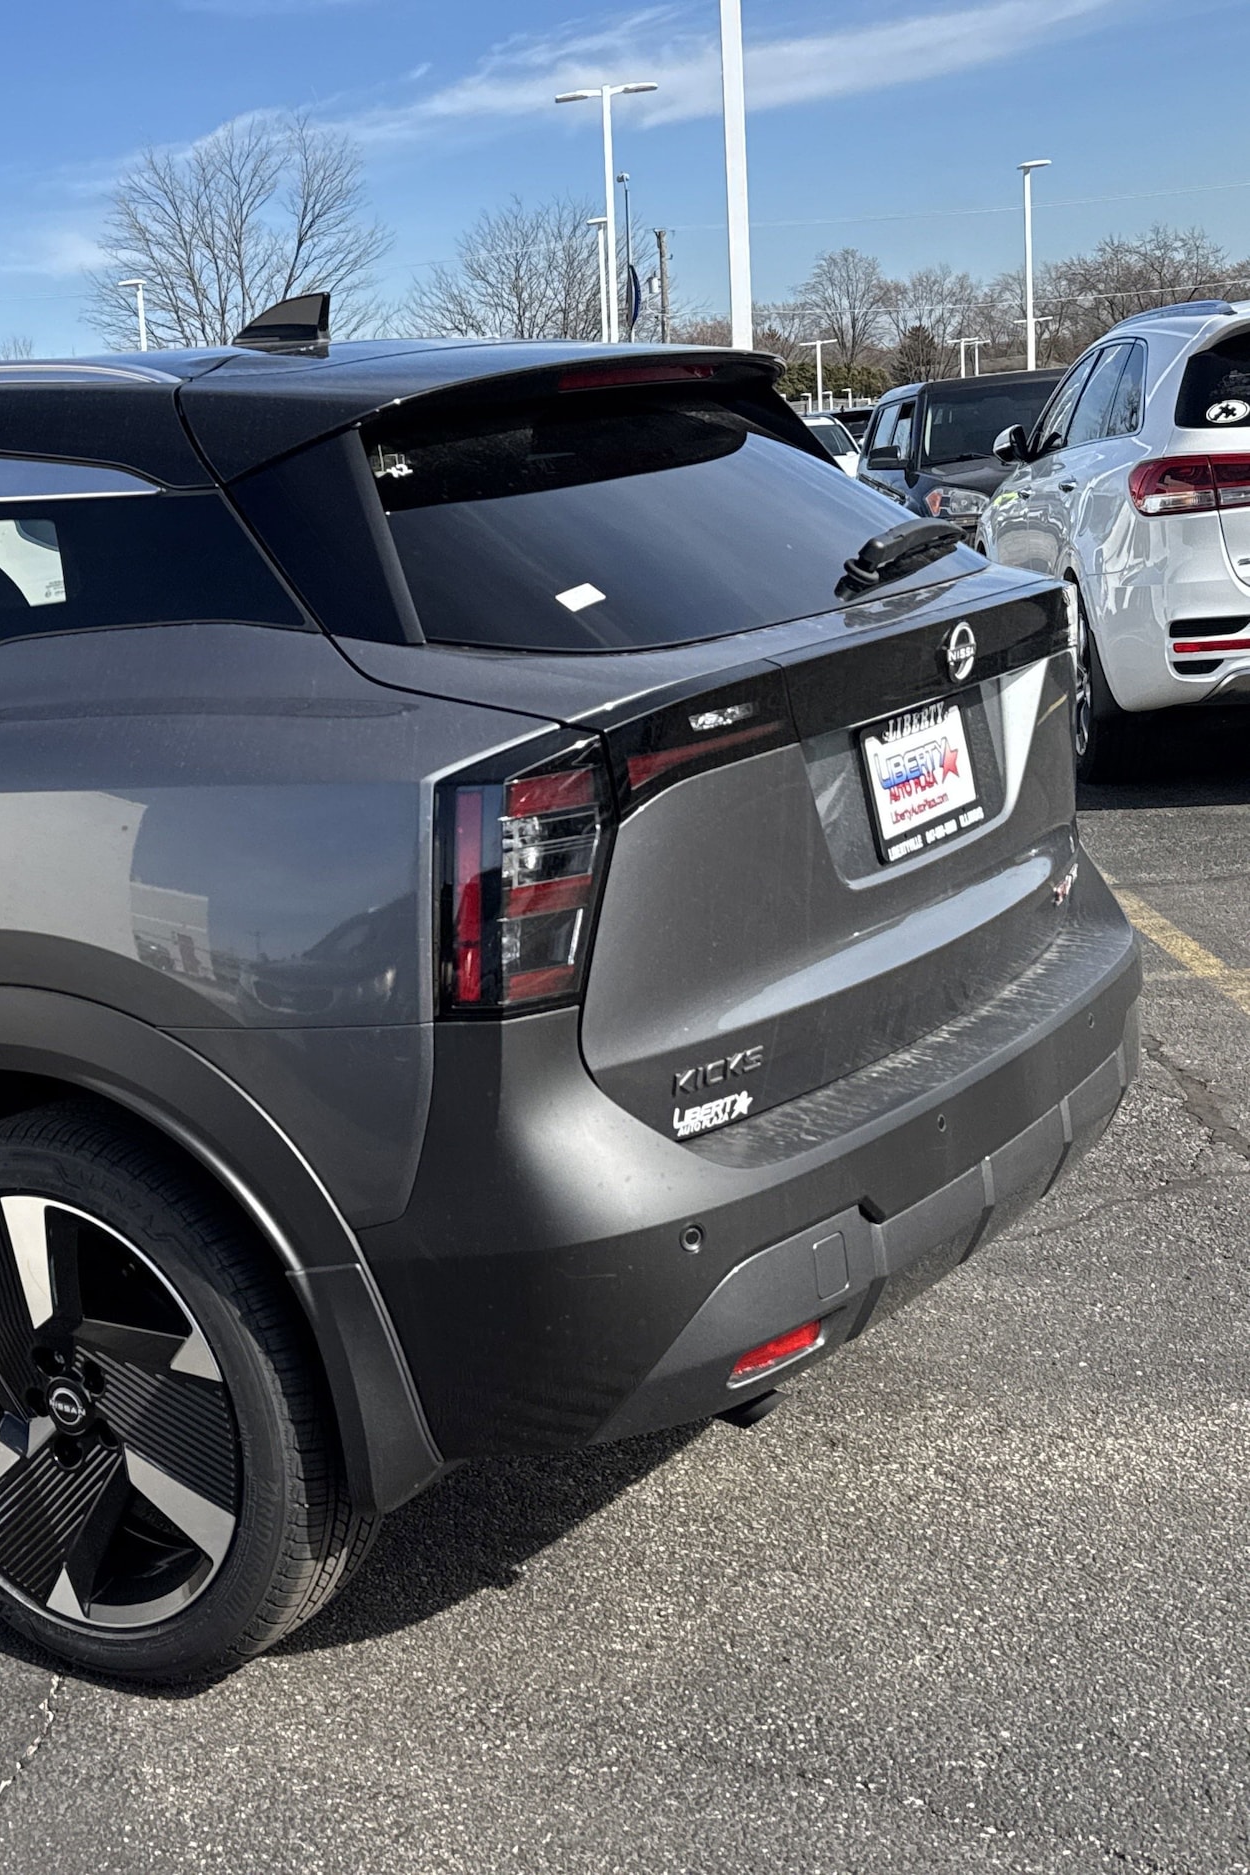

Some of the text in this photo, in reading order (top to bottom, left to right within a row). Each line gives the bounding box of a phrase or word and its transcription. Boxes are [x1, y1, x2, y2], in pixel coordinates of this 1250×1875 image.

[887, 701, 945, 742] LIBERTY
[873, 736, 948, 790] LIBERTY
[889, 781, 913, 804] AUTO
[672, 1045, 764, 1098] KICKS
[673, 1090, 748, 1129] LIBERTY
[677, 1112, 729, 1137] AUTO PLAZA
[49, 1399, 86, 1417] NISSAN
